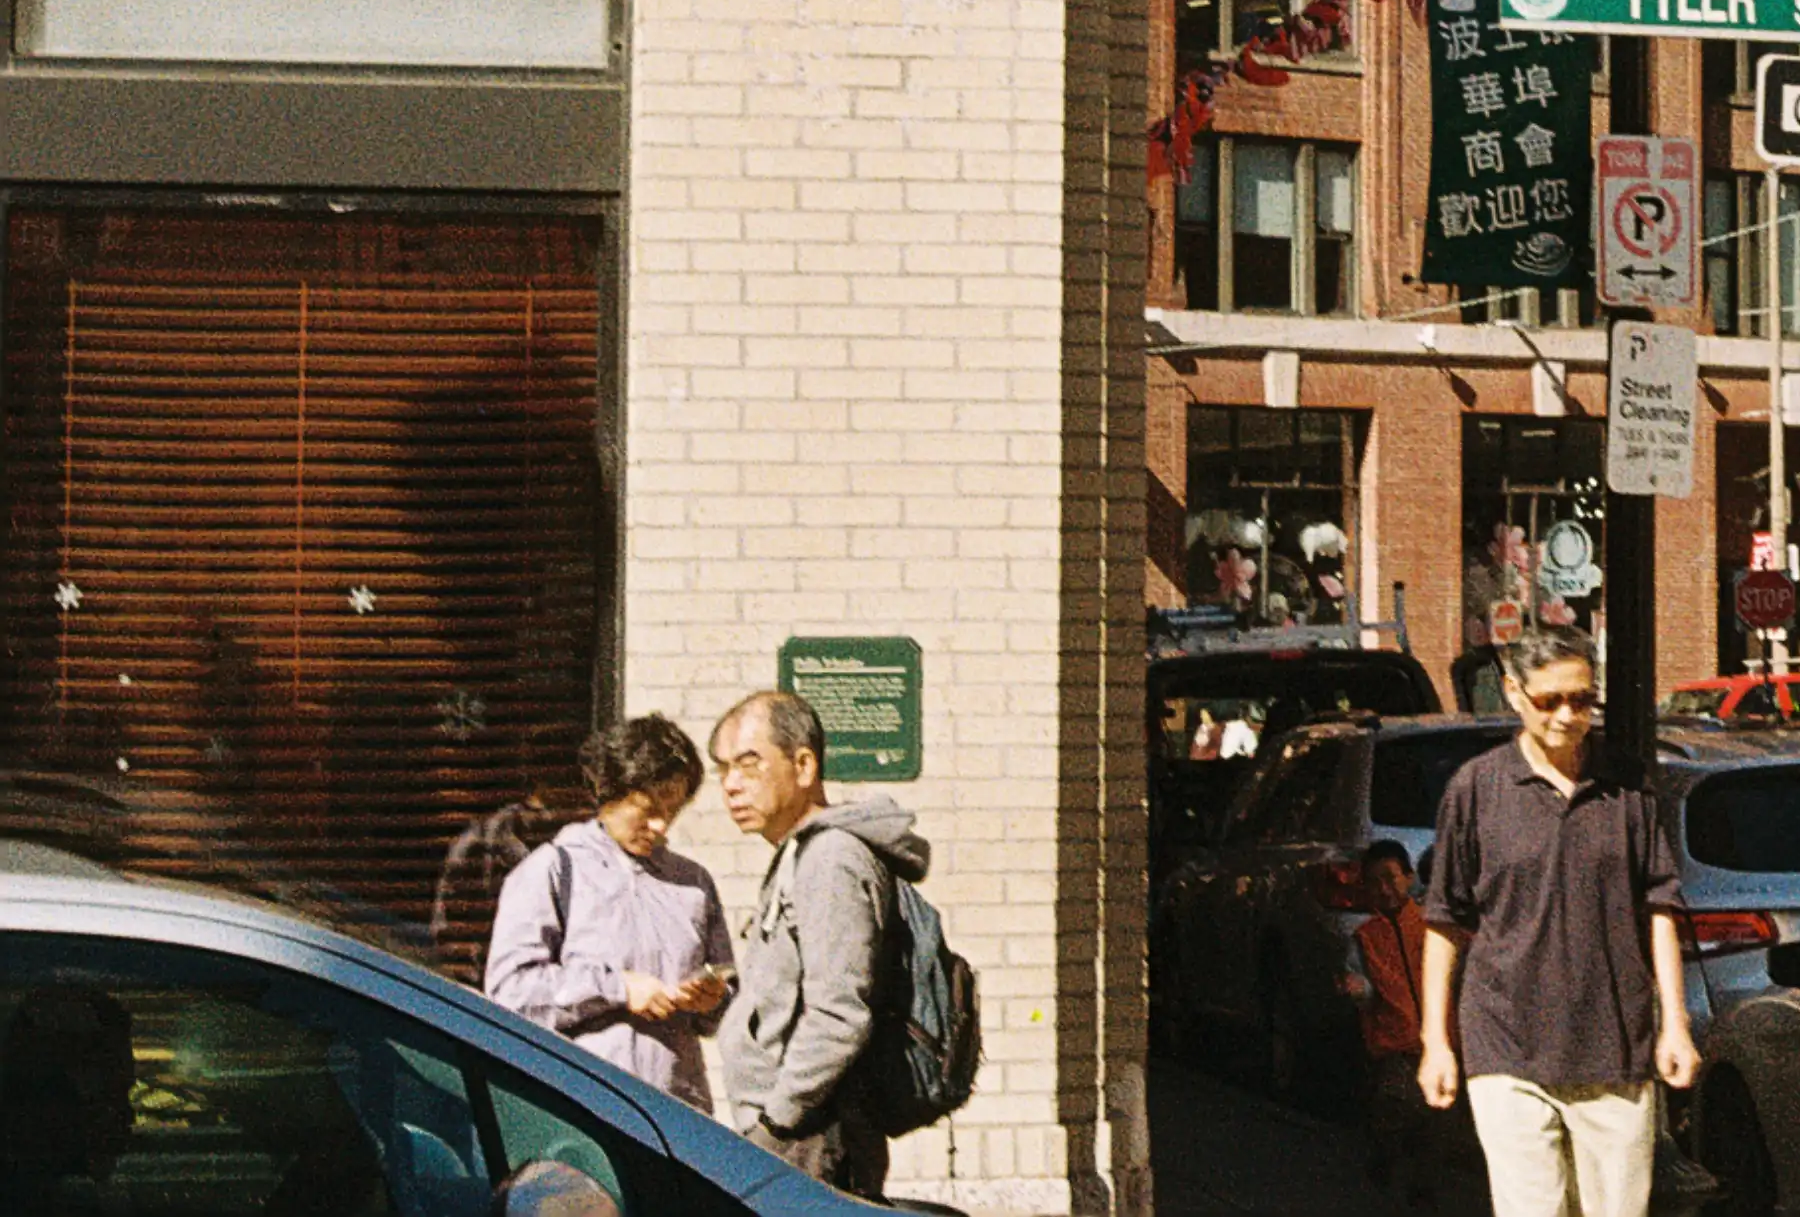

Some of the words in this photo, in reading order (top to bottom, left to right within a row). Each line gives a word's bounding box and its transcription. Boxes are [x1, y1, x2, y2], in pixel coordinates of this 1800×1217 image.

[1460, 64, 1560, 118] 華埠
[1460, 122, 1557, 178] 商會
[1437, 178, 1575, 238] 歡迎您
[1620, 377, 1673, 401] Street
[1619, 400, 1690, 428] Cleaning
[1741, 587, 1792, 611] STOP
